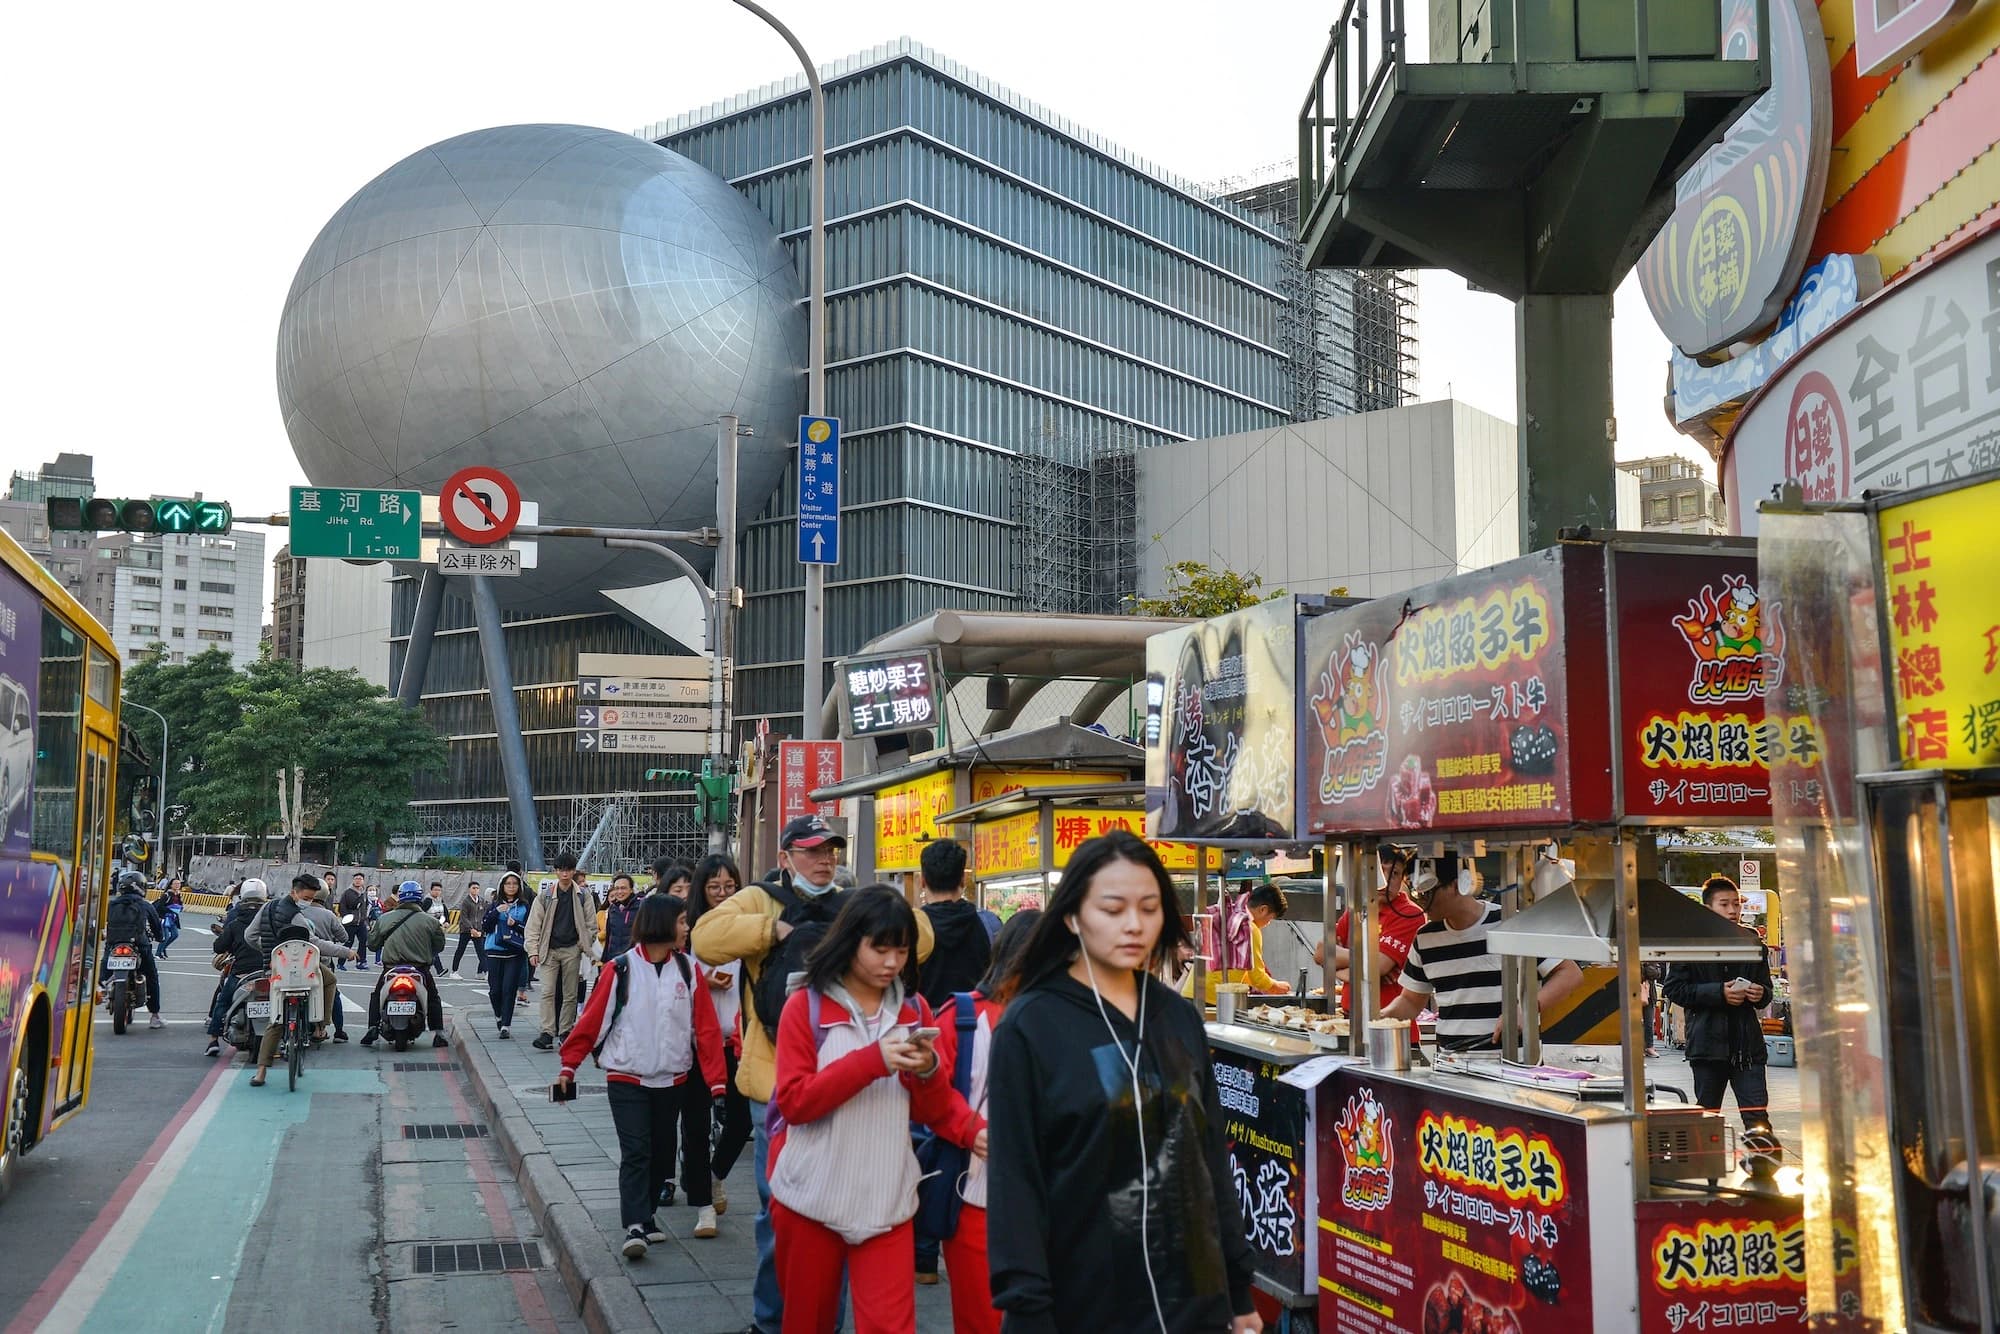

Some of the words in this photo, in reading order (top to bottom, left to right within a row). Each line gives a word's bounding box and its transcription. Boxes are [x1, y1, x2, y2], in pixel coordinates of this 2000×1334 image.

[804, 443, 817, 500] 服務中心
[820, 452, 834, 495] 旅遊
[299, 490, 401, 515] 基河路
[800, 504, 823, 512] Visitor
[326, 516, 349, 526] JiHe
[359, 517, 375, 526] Rd.
[800, 512, 837, 521] Information
[800, 521, 823, 529] Center
[443, 553, 517, 571] 公車除外
[848, 662, 927, 696] 糖炒栗子
[680, 686, 699, 696] 70m
[672, 714, 698, 725] 220m
[853, 696, 932, 730] 手工現炒
[1438, 781, 1557, 815] 嚴選頂級安格斯黑牛
[1424, 1180, 1559, 1249] サイコロロースト牛
